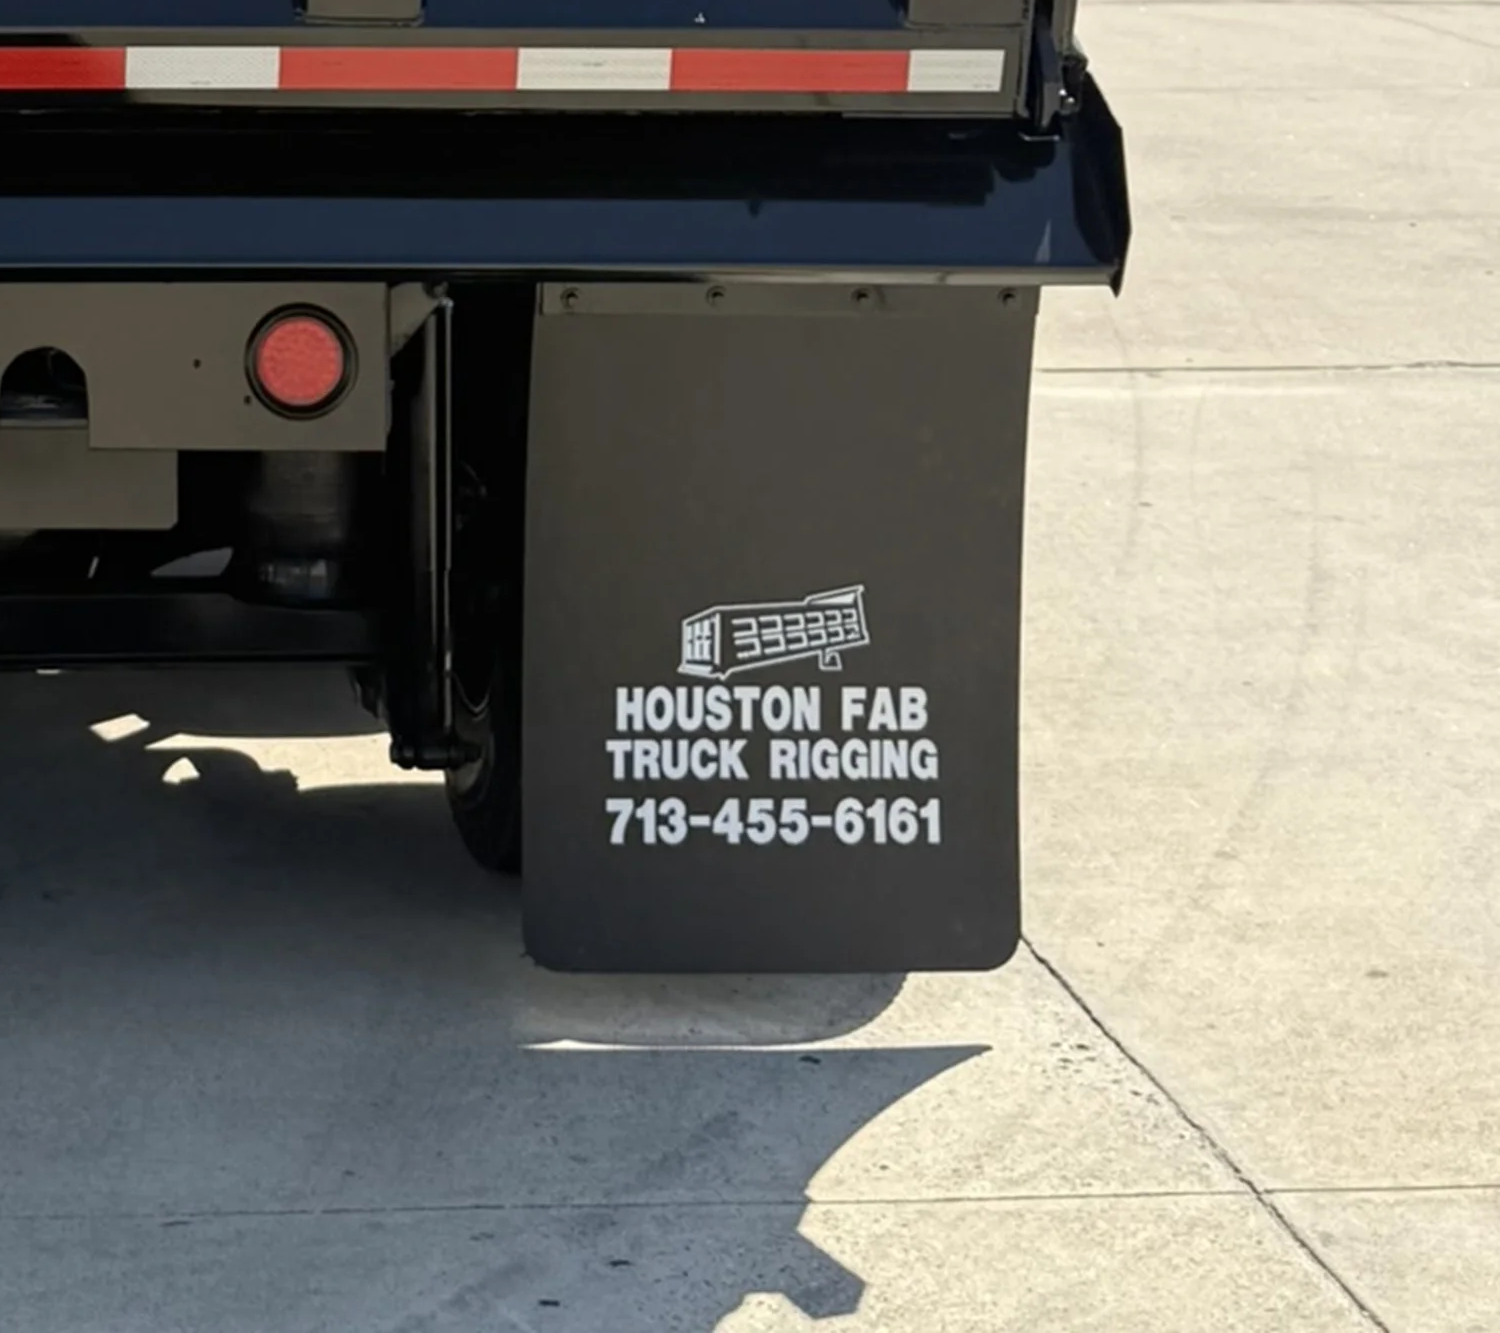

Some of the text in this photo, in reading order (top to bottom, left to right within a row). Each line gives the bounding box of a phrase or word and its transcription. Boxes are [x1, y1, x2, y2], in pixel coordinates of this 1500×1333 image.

[615, 684, 928, 732] HOUSTON FAB
[605, 737, 940, 781] TRUCK RIGGING
[604, 796, 942, 845] 713-455-6161
